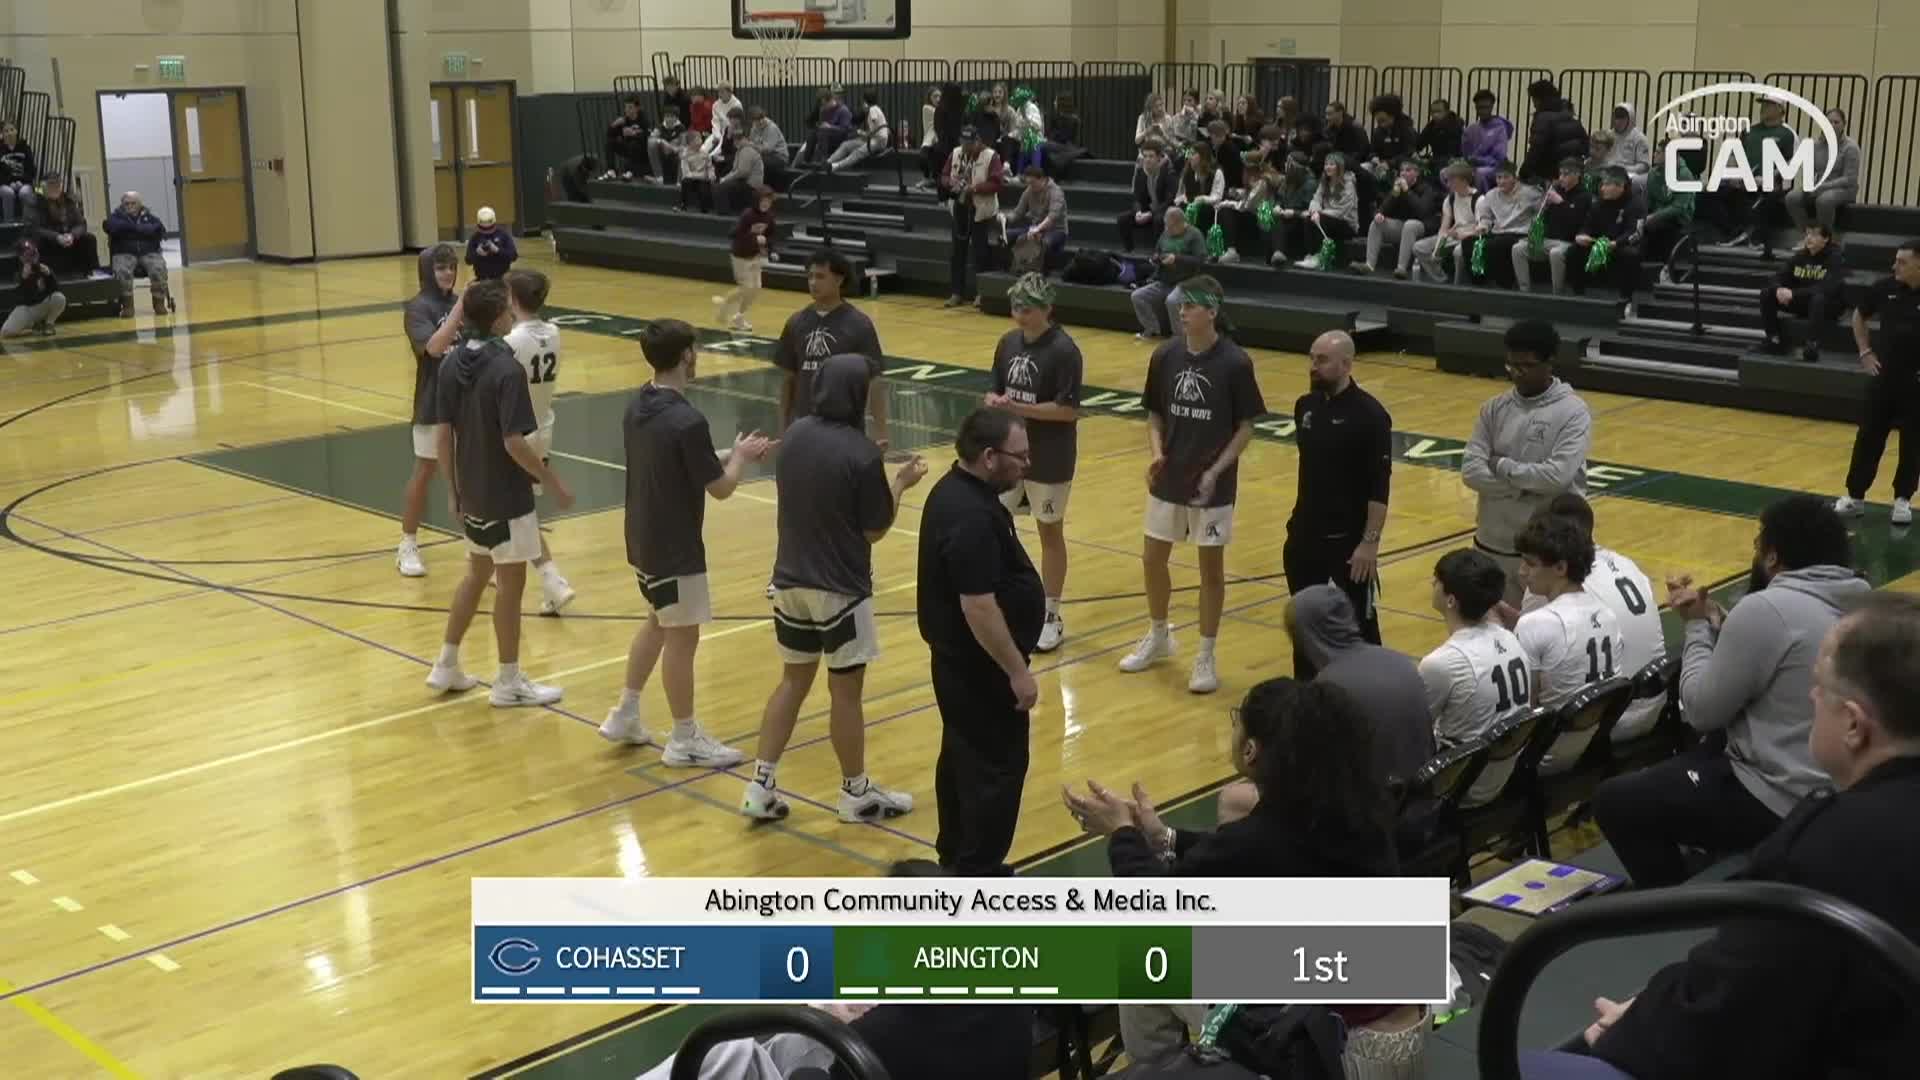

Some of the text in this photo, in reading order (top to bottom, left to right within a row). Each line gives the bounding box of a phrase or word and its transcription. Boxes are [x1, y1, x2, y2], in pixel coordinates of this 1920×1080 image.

[530, 351, 556, 384] 12
[1191, 408, 1212, 420] WAVE
[1614, 576, 1646, 616] 0
[1585, 636, 1615, 684] 11
[1491, 656, 1529, 712] 10
